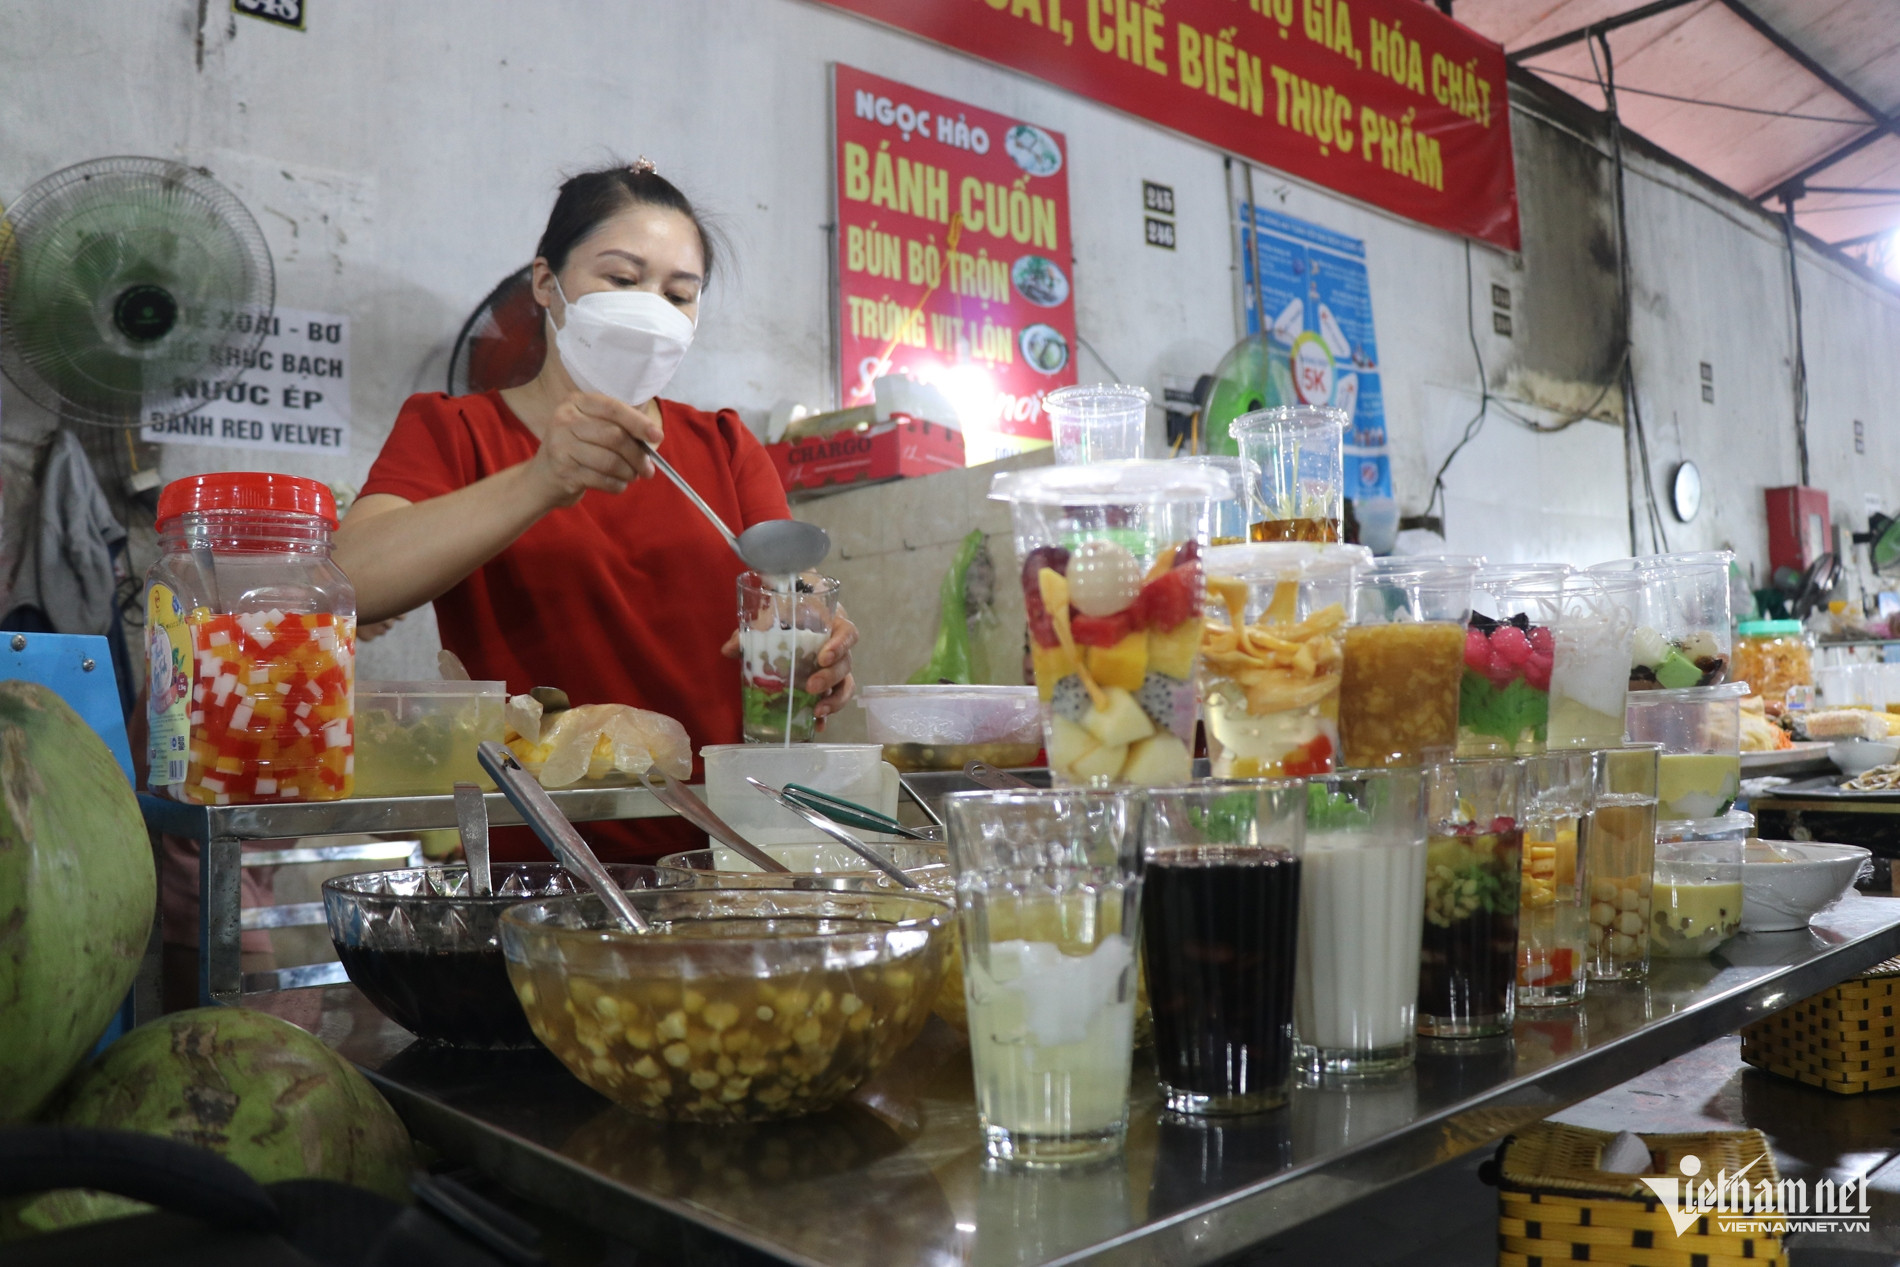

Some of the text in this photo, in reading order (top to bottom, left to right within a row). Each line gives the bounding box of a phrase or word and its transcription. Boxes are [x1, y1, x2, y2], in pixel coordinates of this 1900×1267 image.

[1370, 17, 1426, 96] HÓA
[1432, 57, 1491, 129] CHẤT
[855, 89, 990, 155] NGỌC HẢO
[1177, 26, 1263, 117] BIẾN
[1271, 64, 1354, 157] THỰC
[1360, 106, 1443, 192] PHẨM
[845, 140, 1057, 251] BÁNH CUỐN
[1147, 186, 1172, 212] 245
[1148, 221, 1174, 246] 246
[847, 220, 1010, 310] BÚN BÒ TRỘN
[308, 321, 343, 344] BƠ
[848, 294, 927, 348] TRỨNG
[970, 316, 1014, 369] LỘN
[282, 352, 344, 379] BẠCH
[1303, 367, 1327, 393] 5K
[283, 384, 323, 410] ÉP
[222, 418, 264, 441] RED
[271, 421, 344, 447] VELVET
[787, 437, 873, 465] CHARGO
